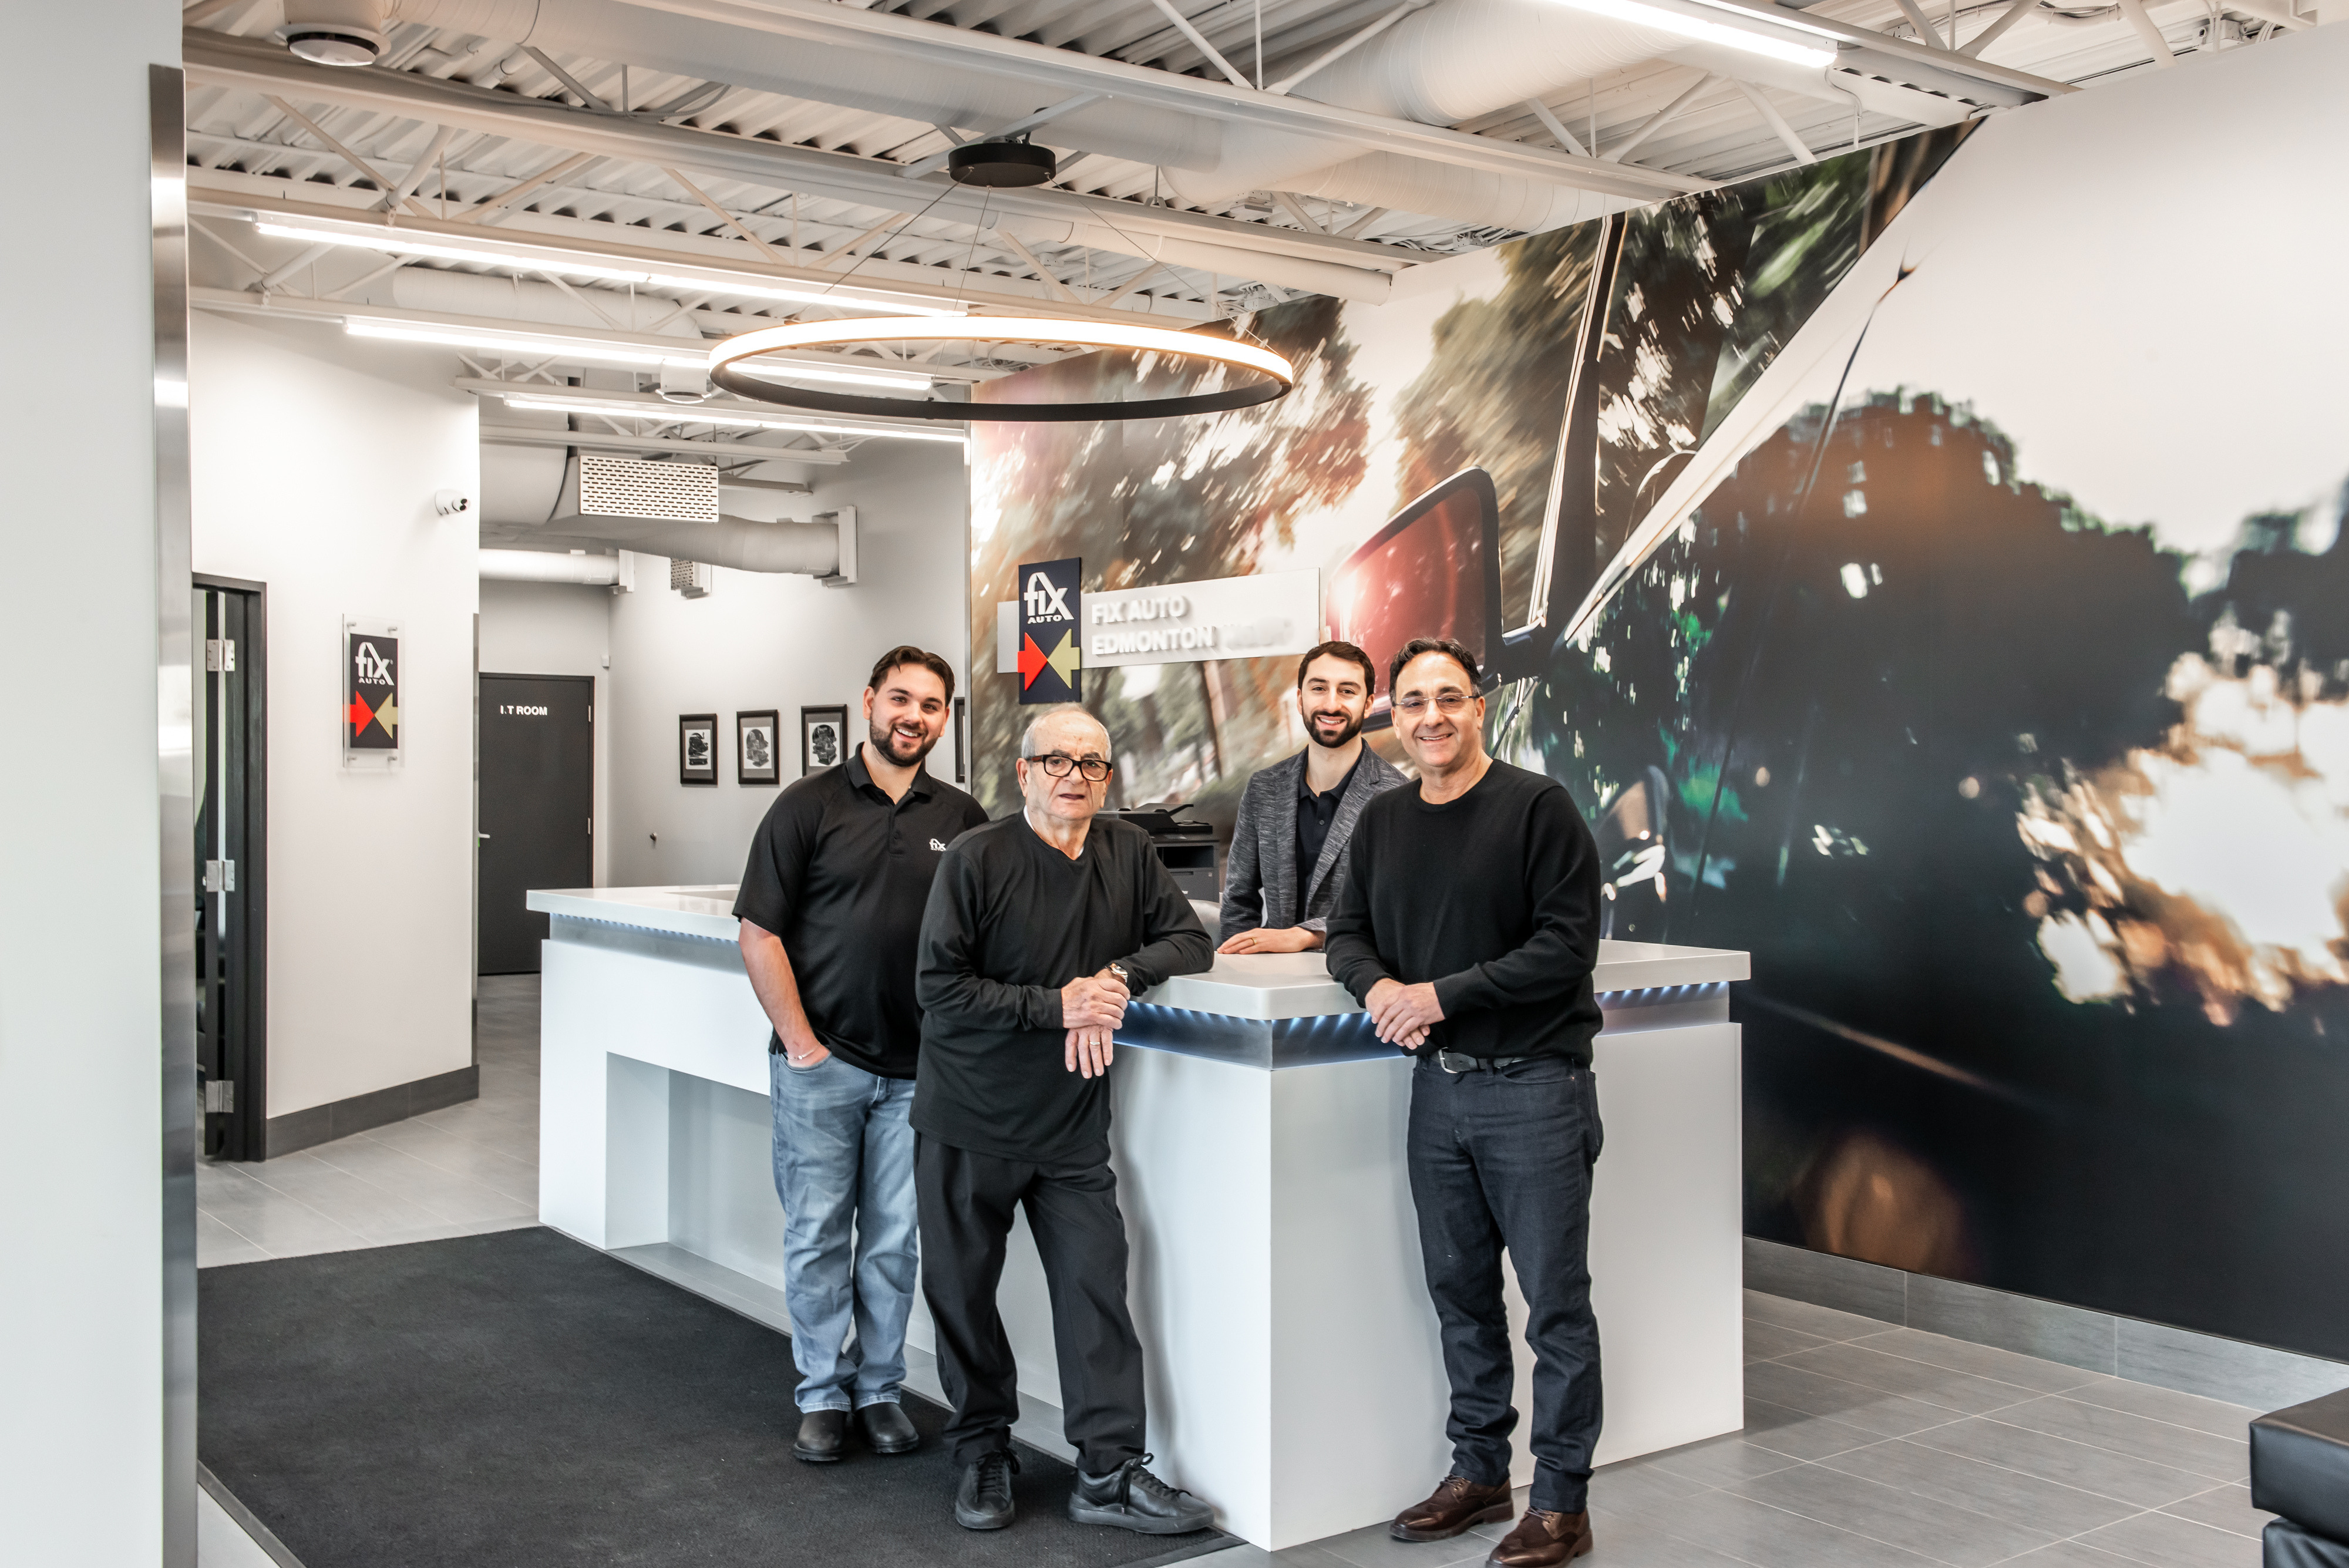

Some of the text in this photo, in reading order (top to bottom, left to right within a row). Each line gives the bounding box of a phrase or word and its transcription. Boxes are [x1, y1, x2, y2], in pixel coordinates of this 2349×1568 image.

[1092, 595, 1189, 624] FIX AUTO
[1027, 614, 1063, 624] AUTO
[1092, 625, 1216, 655] EDMONTON
[358, 677, 386, 685] AUTO
[500, 705, 548, 716] I.T ROOM
